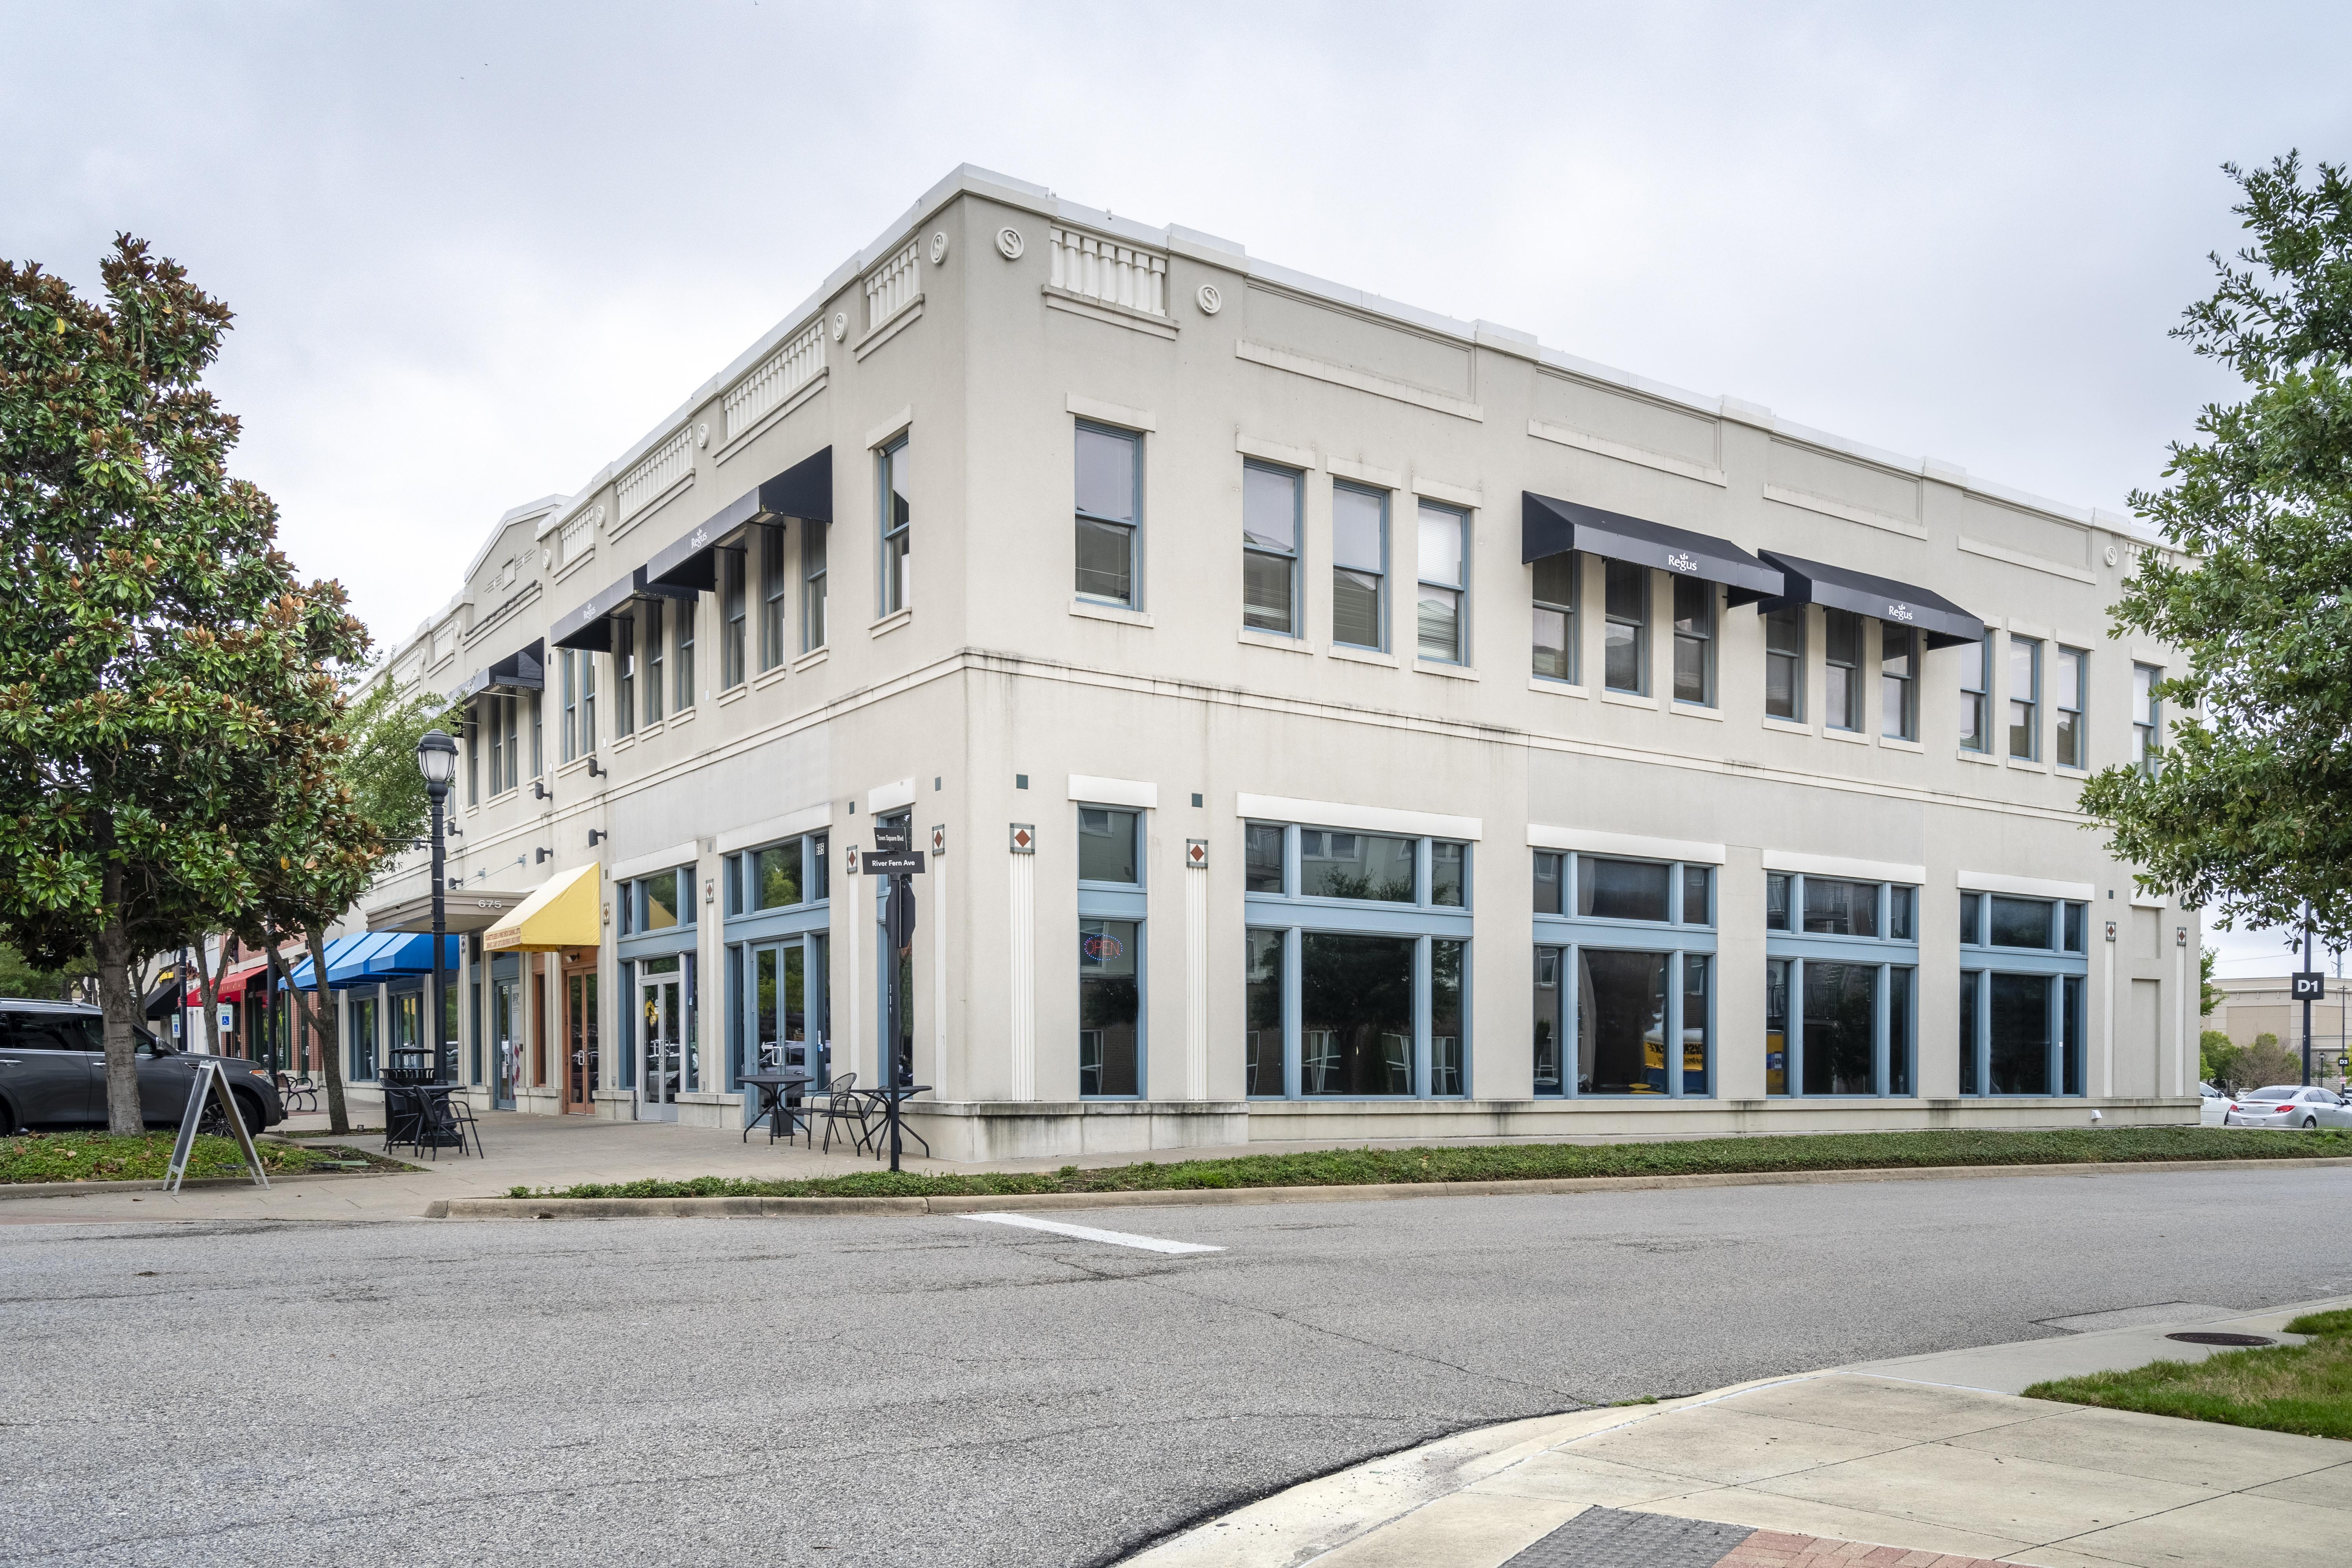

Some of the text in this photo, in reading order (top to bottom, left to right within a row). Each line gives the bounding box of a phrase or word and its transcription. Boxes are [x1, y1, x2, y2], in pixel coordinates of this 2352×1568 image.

[691, 532, 707, 549] Regus
[1668, 554, 1697, 571] Regus
[583, 606, 595, 620] Regus
[1889, 605, 1913, 620] Regus
[478, 899, 502, 908] 675
[1086, 940, 1119, 955] OPEN
[2298, 979, 2318, 992] D1
